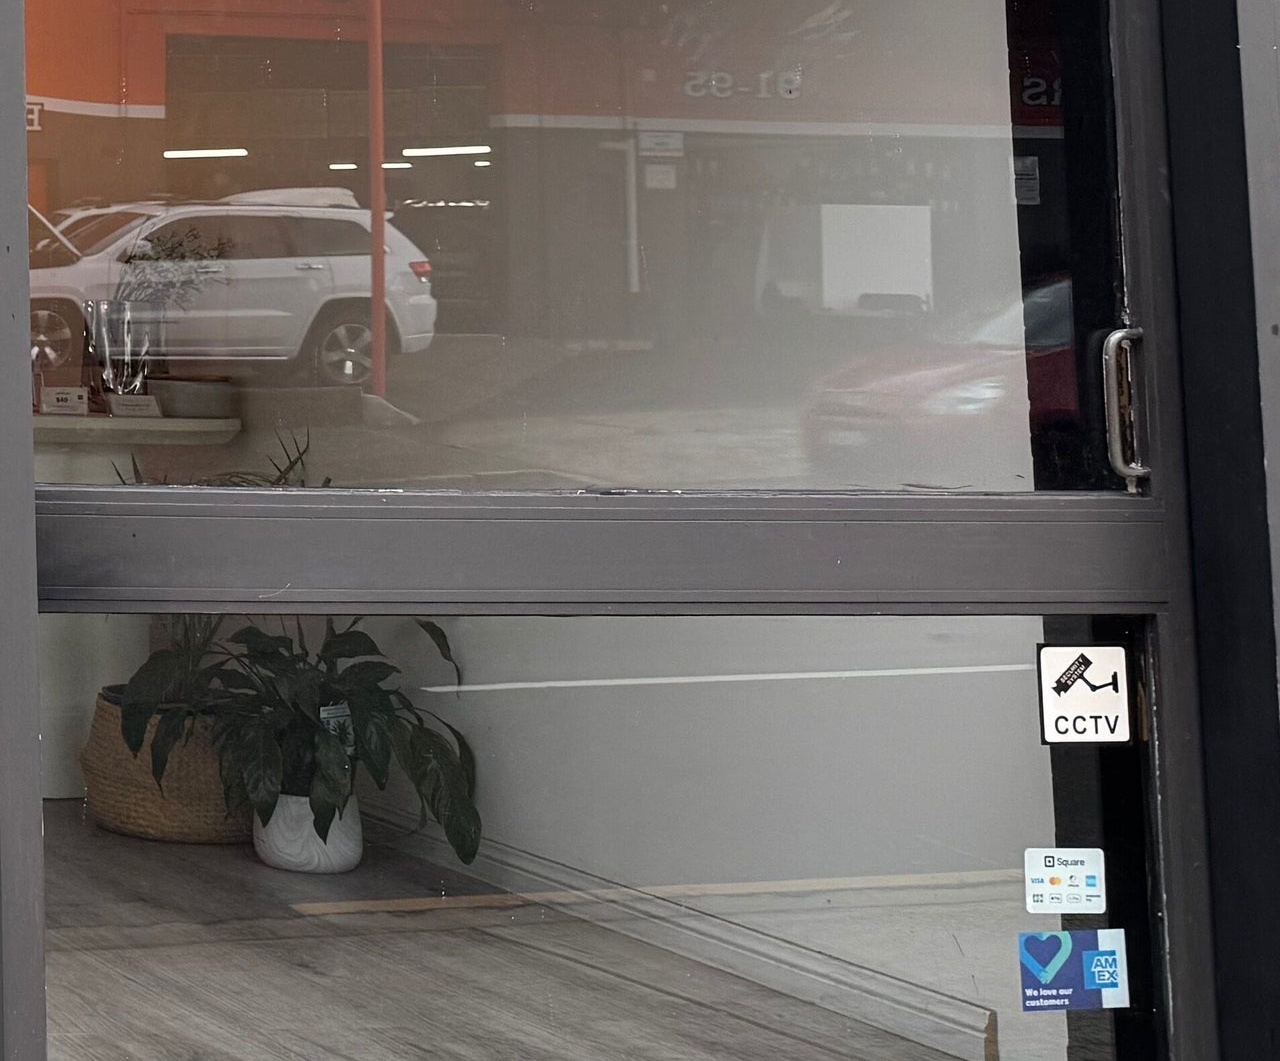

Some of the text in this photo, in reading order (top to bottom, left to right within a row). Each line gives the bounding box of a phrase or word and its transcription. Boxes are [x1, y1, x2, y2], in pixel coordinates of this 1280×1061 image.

[1054, 715, 1119, 735] CCTV
[1057, 857, 1085, 868] Square
[1025, 987, 1073, 997] We love our
[1025, 997, 1069, 1007] customers
